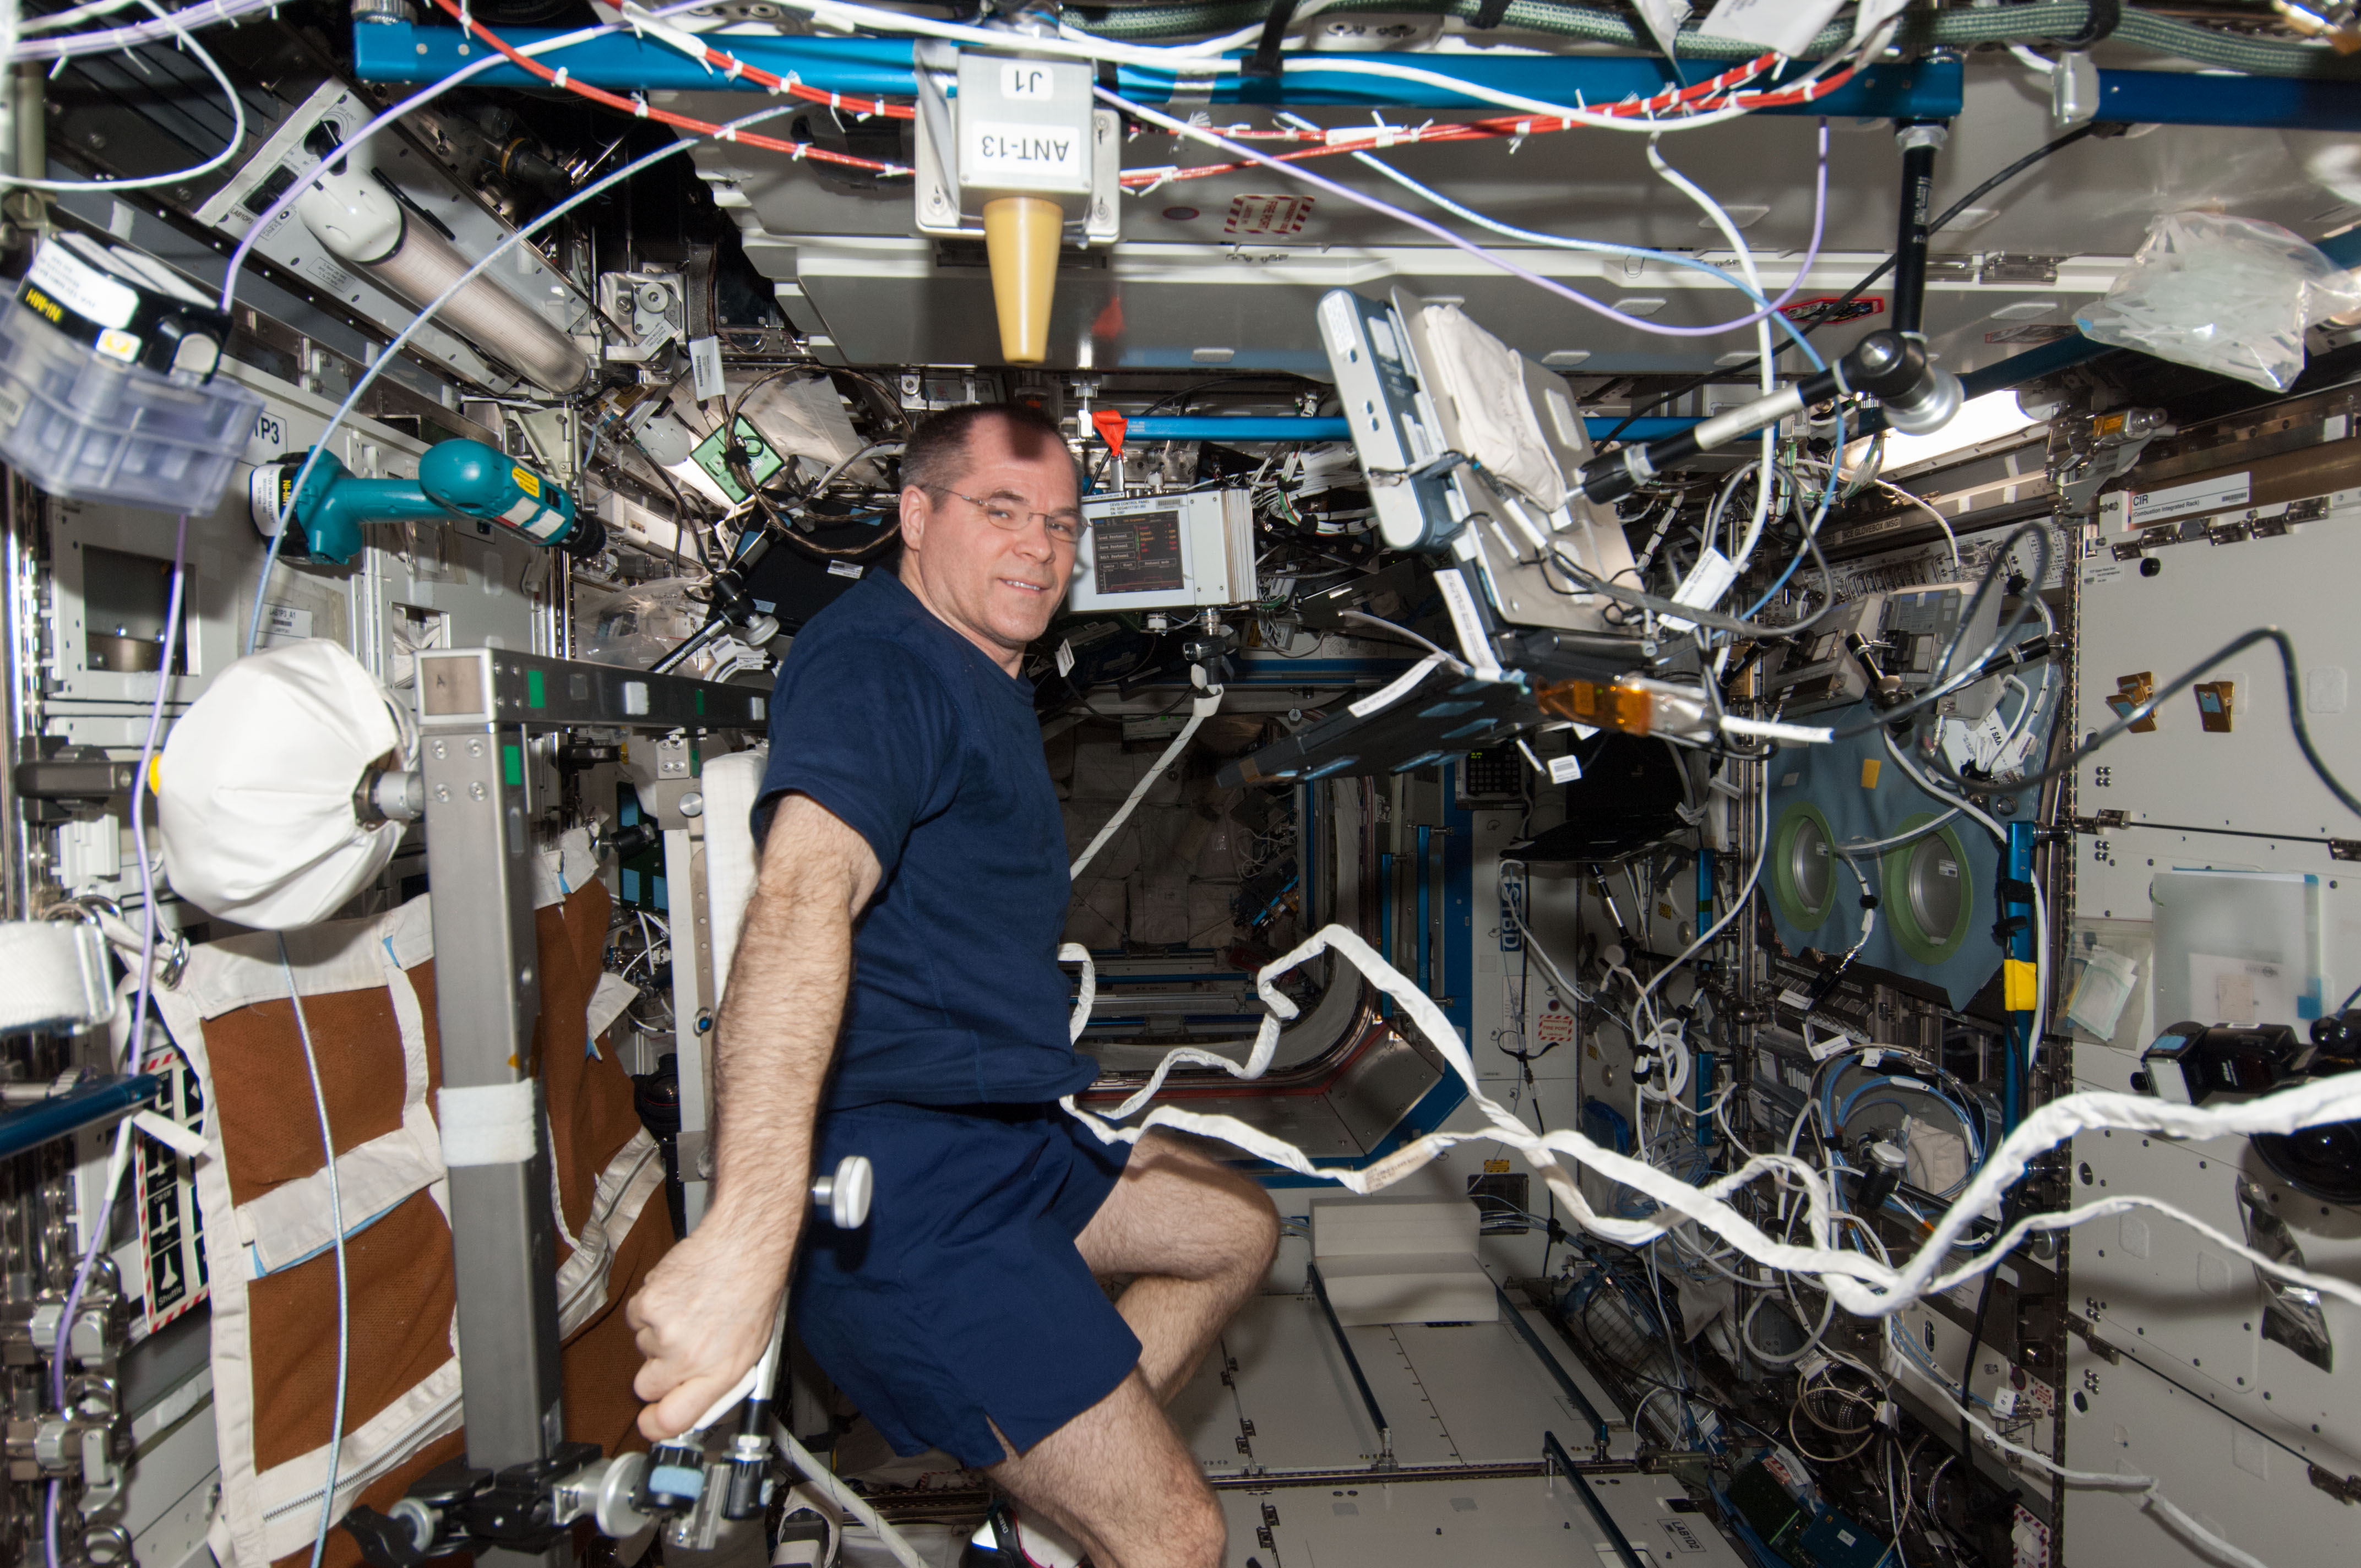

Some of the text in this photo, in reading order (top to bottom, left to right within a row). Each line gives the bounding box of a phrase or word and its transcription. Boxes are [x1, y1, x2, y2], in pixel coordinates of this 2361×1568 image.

[1015, 69, 1042, 94] J1
[982, 135, 1069, 162] ANT-13
[2133, 494, 2148, 506] CIR
[2161, 502, 2185, 513] Integrated
[2186, 499, 2200, 508] Rack)
[1854, 521, 1883, 538] GLOVEBOX
[1884, 518, 1901, 530] (MSG)
[158, 1284, 183, 1306] Shuttle
[1671, 1521, 1700, 1550] LAB1D2
